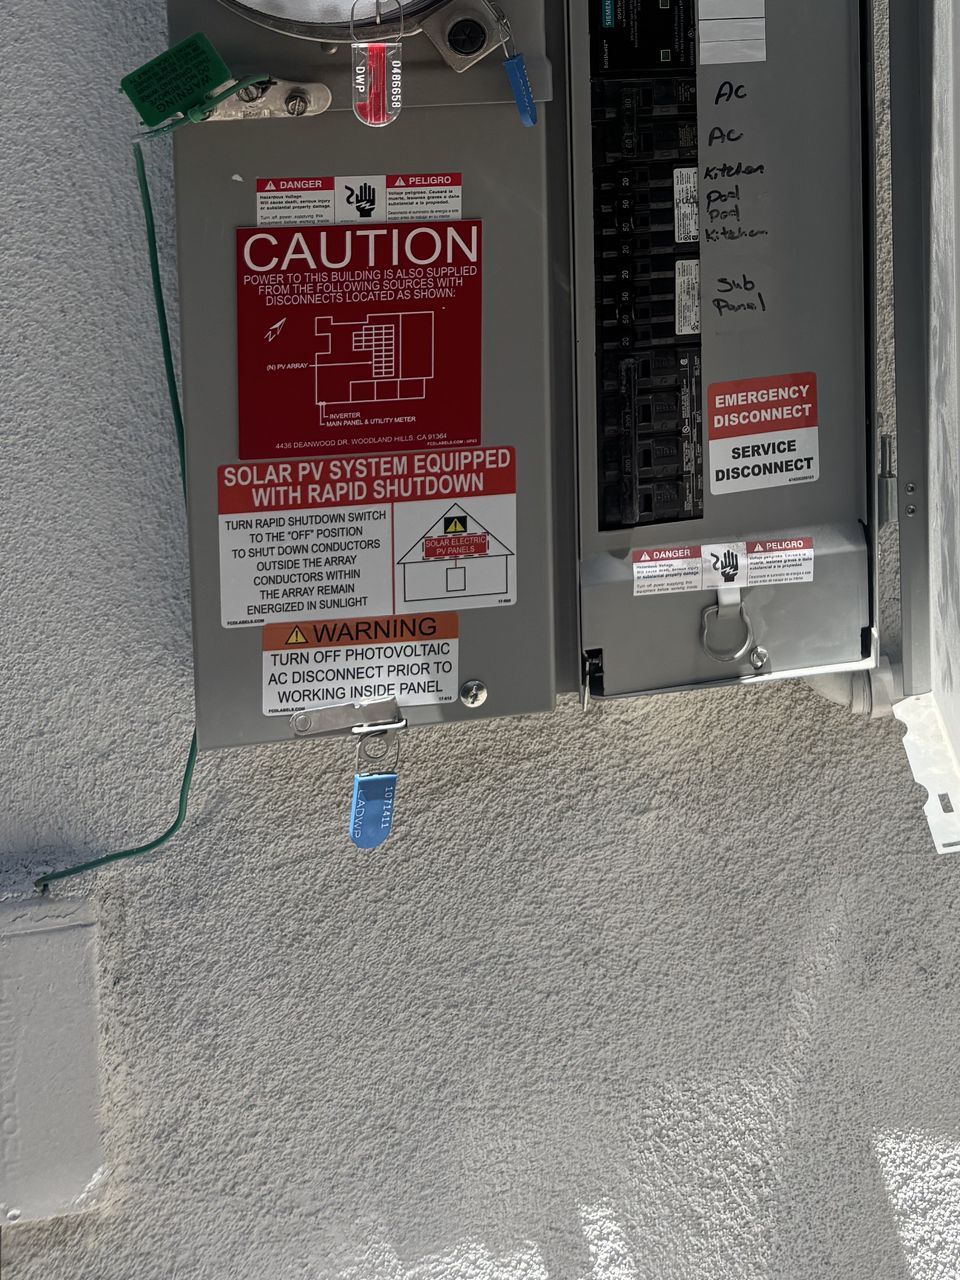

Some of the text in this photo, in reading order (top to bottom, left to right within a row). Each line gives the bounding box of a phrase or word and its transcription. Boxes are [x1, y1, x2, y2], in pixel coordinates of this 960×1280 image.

[355, 66, 366, 93] DWP
[391, 60, 402, 108] 0486658
[714, 81, 748, 104] AC
[280, 180, 321, 188] DANGER
[408, 175, 451, 184] PELIGRO
[244, 227, 476, 270] CAUTION
[243, 266, 477, 284] POWER TO THIS BUILDING IS ALSO SUPPLIED
[258, 276, 462, 294] FROM THE FOLLOWING SOURCES WITH
[266, 287, 455, 305] DISCONNECTS LOCATED AS SHOWN:
[715, 385, 808, 407] EMERGENCY
[714, 404, 810, 427] DISCONNECT
[731, 439, 797, 460] SERVICE
[224, 449, 509, 486] SOLAR PV SYSTEM EQUIPPED
[715, 457, 814, 482] DISCONNECT
[252, 473, 483, 506] WITH RAPID SHUTDOWN
[225, 510, 386, 530] TURN RAPID SHUTDOWN SWITCH
[249, 526, 362, 543] TO THE "OFF" POSITION
[424, 535, 485, 547] SOLAR ELECTRIC
[766, 540, 803, 549] PELIGRO
[447, 545, 474, 555] PANELS
[653, 549, 690, 558] DANGER
[313, 617, 436, 642] WARNING
[271, 642, 449, 665] TURN OFF PHOTOVOLTAIC
[268, 660, 452, 685] AC DISCONNECT PRIOR TO
[277, 680, 442, 702] WORKING INSIDE PANEL
[353, 789, 366, 838] LADWP
[381, 786, 393, 829] 1071411
